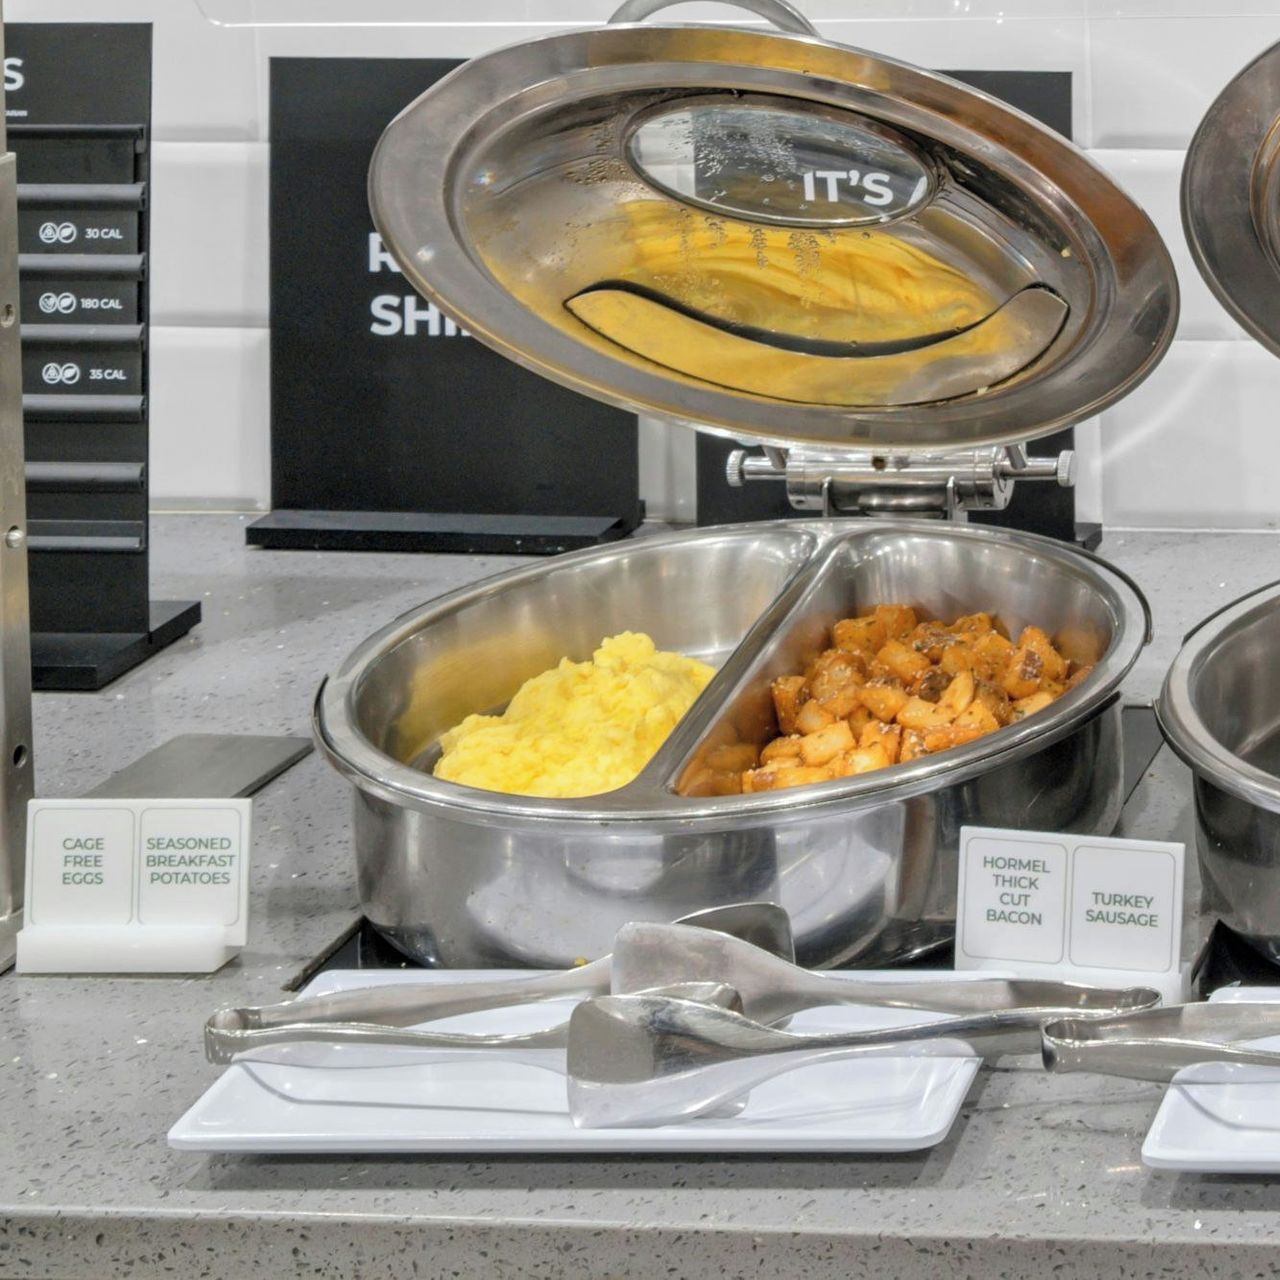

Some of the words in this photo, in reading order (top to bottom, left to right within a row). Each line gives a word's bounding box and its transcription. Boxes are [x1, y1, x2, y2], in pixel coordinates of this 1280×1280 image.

[85, 227, 99, 240] 30
[100, 227, 123, 240] CAL
[80, 297, 99, 309] 180
[100, 297, 123, 310] CAL
[88, 369, 102, 380] 35
[103, 369, 127, 381] CAL
[63, 838, 103, 850] CAGE
[147, 838, 231, 850] SEASONED
[64, 856, 102, 867] FREE
[147, 855, 234, 867] BREAKFAST
[983, 856, 1050, 873] HORMEL
[63, 872, 103, 884] EGGS
[151, 872, 230, 884] POTATOES
[993, 874, 1038, 889] THICK
[1000, 893, 1030, 906] CUT
[1093, 892, 1153, 908] TURKEY
[987, 909, 1041, 925] BACON
[1086, 909, 1158, 927] SAUSAGE
